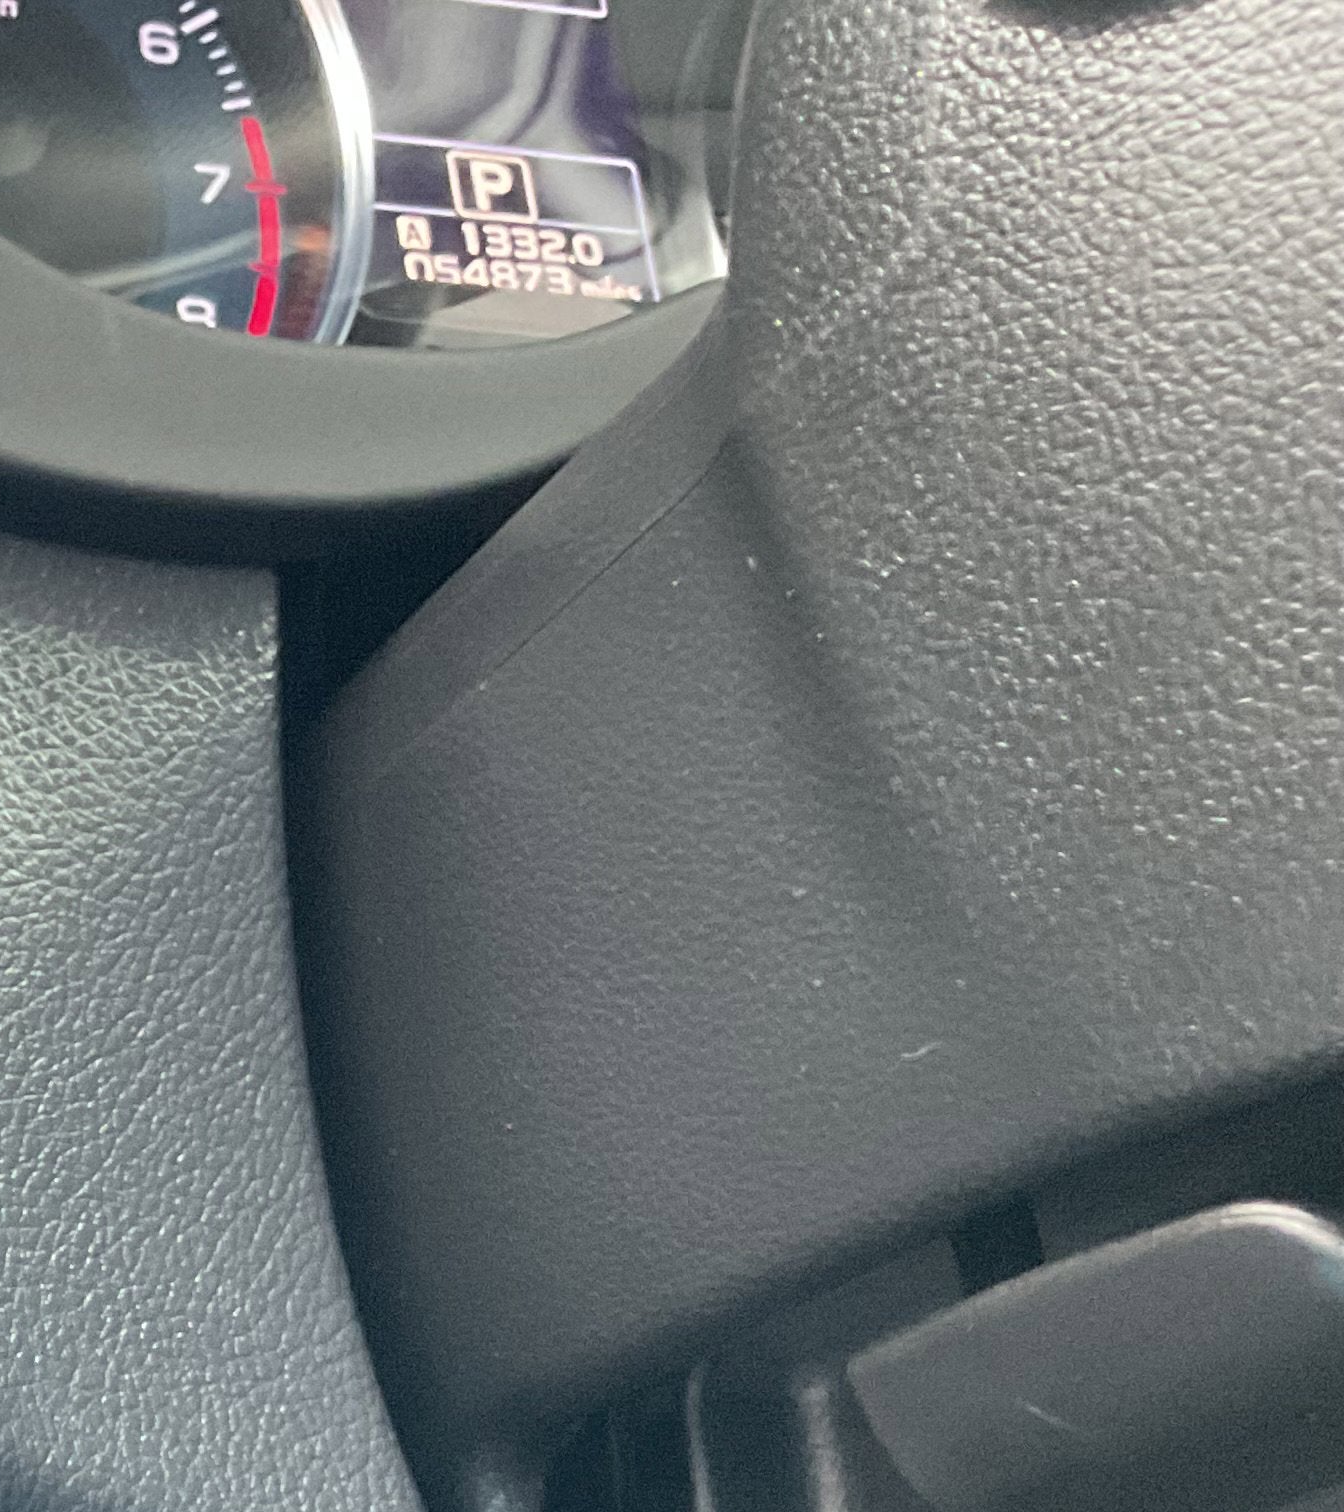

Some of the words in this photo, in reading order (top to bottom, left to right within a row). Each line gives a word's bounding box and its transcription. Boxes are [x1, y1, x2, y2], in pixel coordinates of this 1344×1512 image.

[139, 21, 179, 65] 6
[194, 161, 231, 204] 7
[469, 158, 513, 213] P
[461, 221, 604, 266] 1332.0
